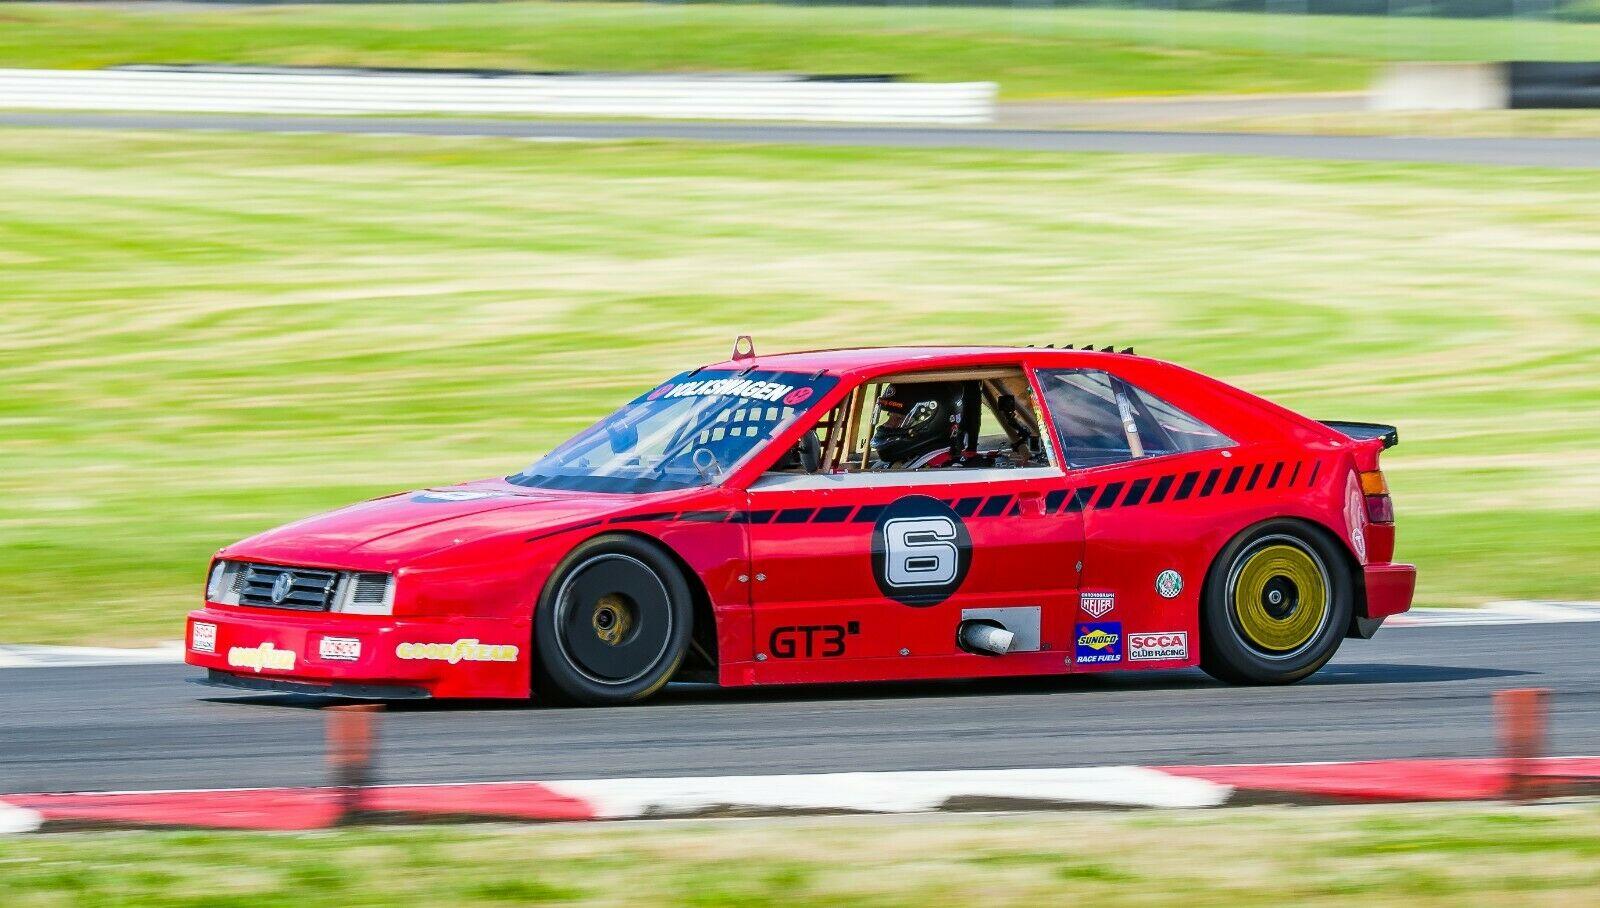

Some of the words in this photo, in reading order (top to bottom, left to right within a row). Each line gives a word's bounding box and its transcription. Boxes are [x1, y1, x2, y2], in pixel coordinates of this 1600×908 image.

[664, 378, 793, 402] VOLKSWAGEN
[883, 515, 958, 588] 6
[1083, 599, 1112, 615] HEUER
[769, 624, 846, 659] GT3
[1079, 634, 1117, 645] SUNOCO
[1131, 635, 1184, 649] SCCA
[397, 639, 519, 664] GOODYEAR
[1077, 655, 1098, 663] RACE
[1098, 654, 1121, 662] FUELS
[1131, 649, 1154, 658] CLUB
[1155, 649, 1185, 657] RACING
